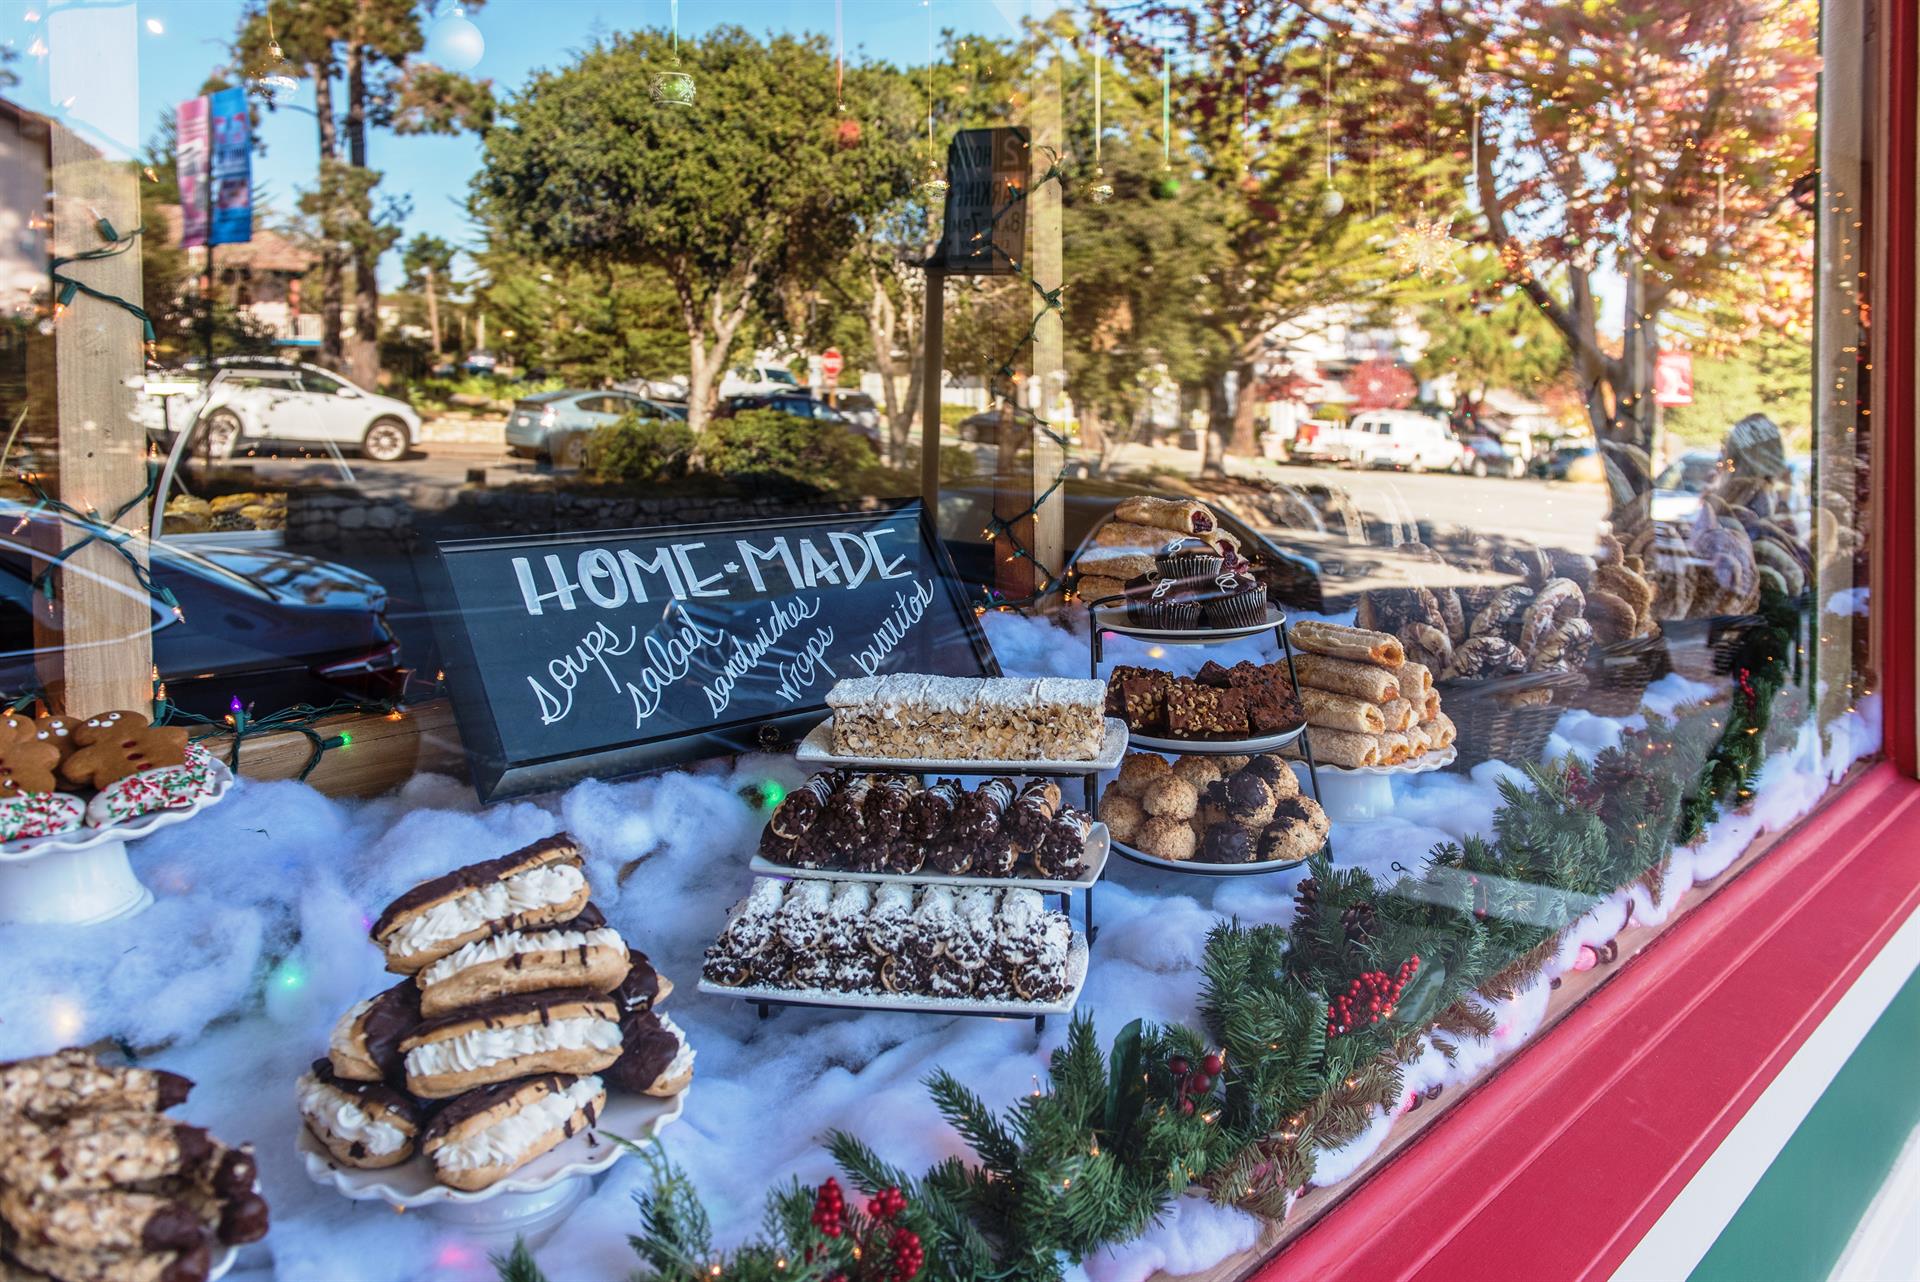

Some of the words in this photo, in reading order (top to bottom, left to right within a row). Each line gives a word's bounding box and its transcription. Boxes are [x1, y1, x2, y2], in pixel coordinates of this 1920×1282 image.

[527, 621, 636, 725] soups
[702, 596, 820, 719] sandwiches
[776, 625, 837, 703] wraps
[850, 578, 934, 677] burritos
